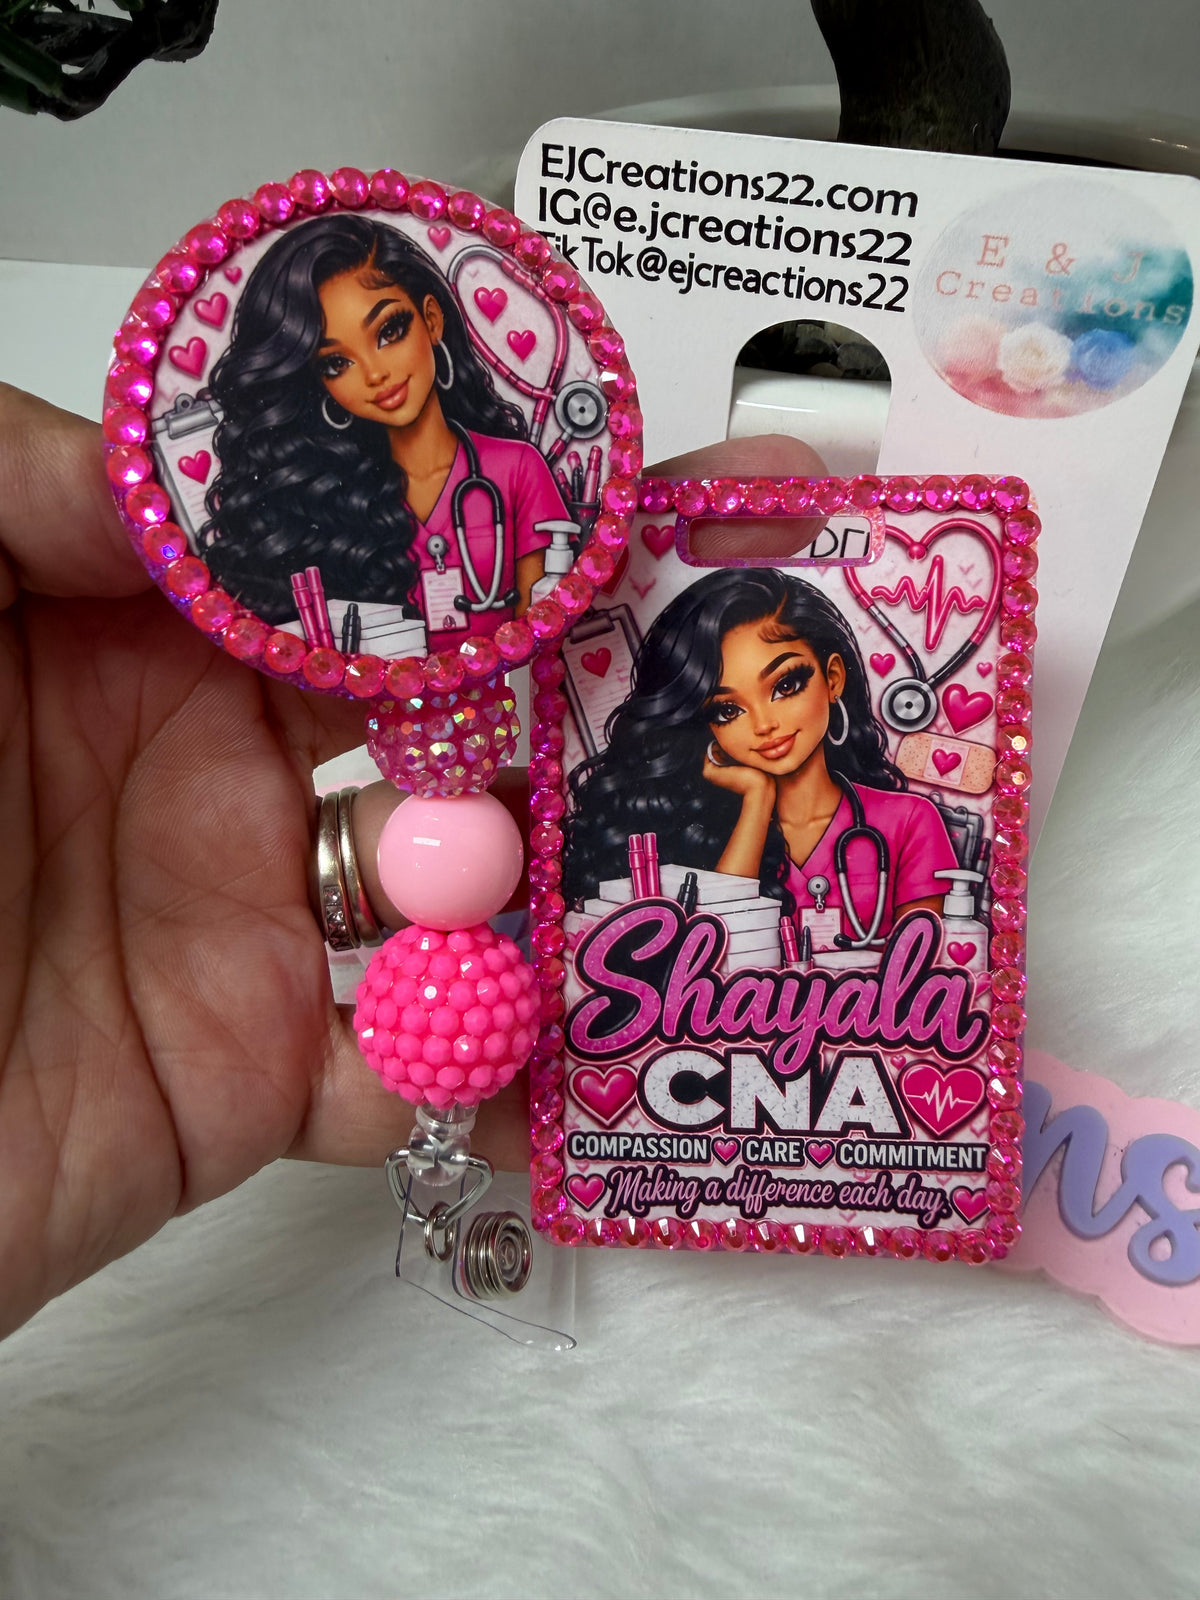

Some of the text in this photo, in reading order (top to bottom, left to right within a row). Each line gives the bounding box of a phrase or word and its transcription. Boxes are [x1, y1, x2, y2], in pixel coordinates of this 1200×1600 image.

[541, 142, 918, 218] EJCreations22.com
[538, 186, 912, 266] IG@e.jcreations22
[976, 234, 1146, 283] E & J
[935, 270, 1186, 325] Creations
[571, 908, 983, 1074] Shayala
[642, 1051, 901, 1133] CNA
[571, 1134, 986, 1169] COMPASSION CARE COMMITMENT
[610, 1168, 947, 1225] Making a difference each day.
